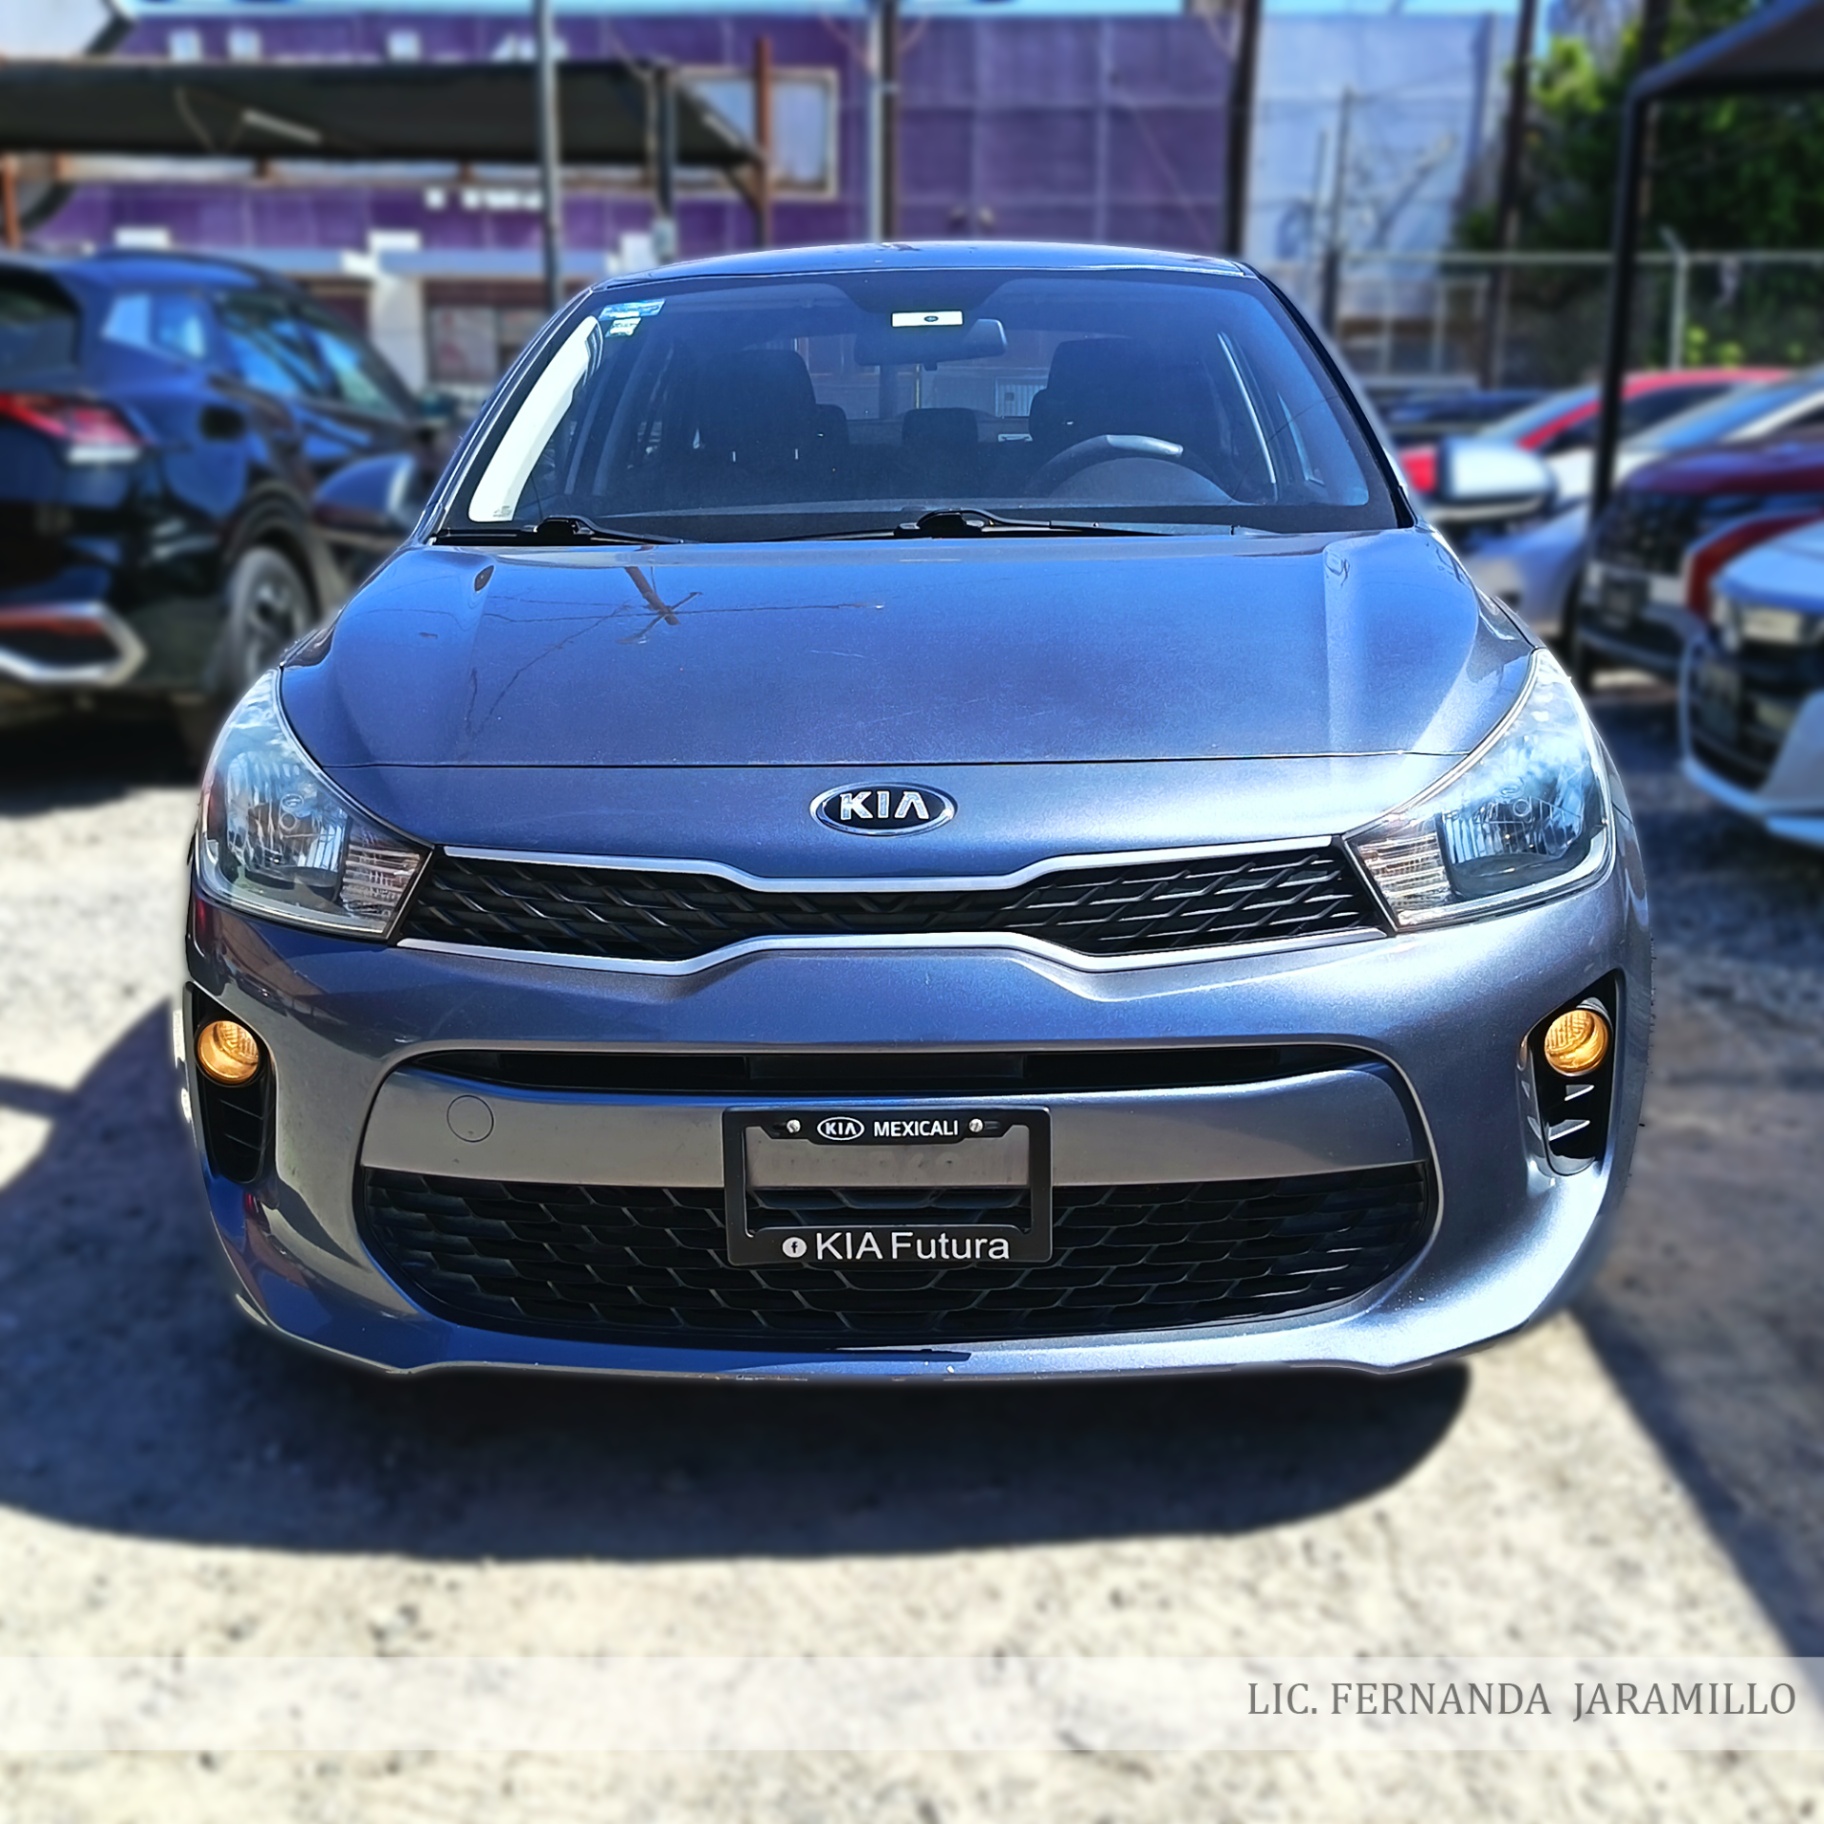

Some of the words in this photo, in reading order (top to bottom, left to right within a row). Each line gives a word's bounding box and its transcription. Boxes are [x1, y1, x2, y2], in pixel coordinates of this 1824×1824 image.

[839, 790, 930, 821] KIA
[825, 1121, 858, 1136] KIA
[873, 1120, 959, 1137] MEXICALI
[816, 1232, 882, 1260] KIA
[892, 1232, 1010, 1260] Futura
